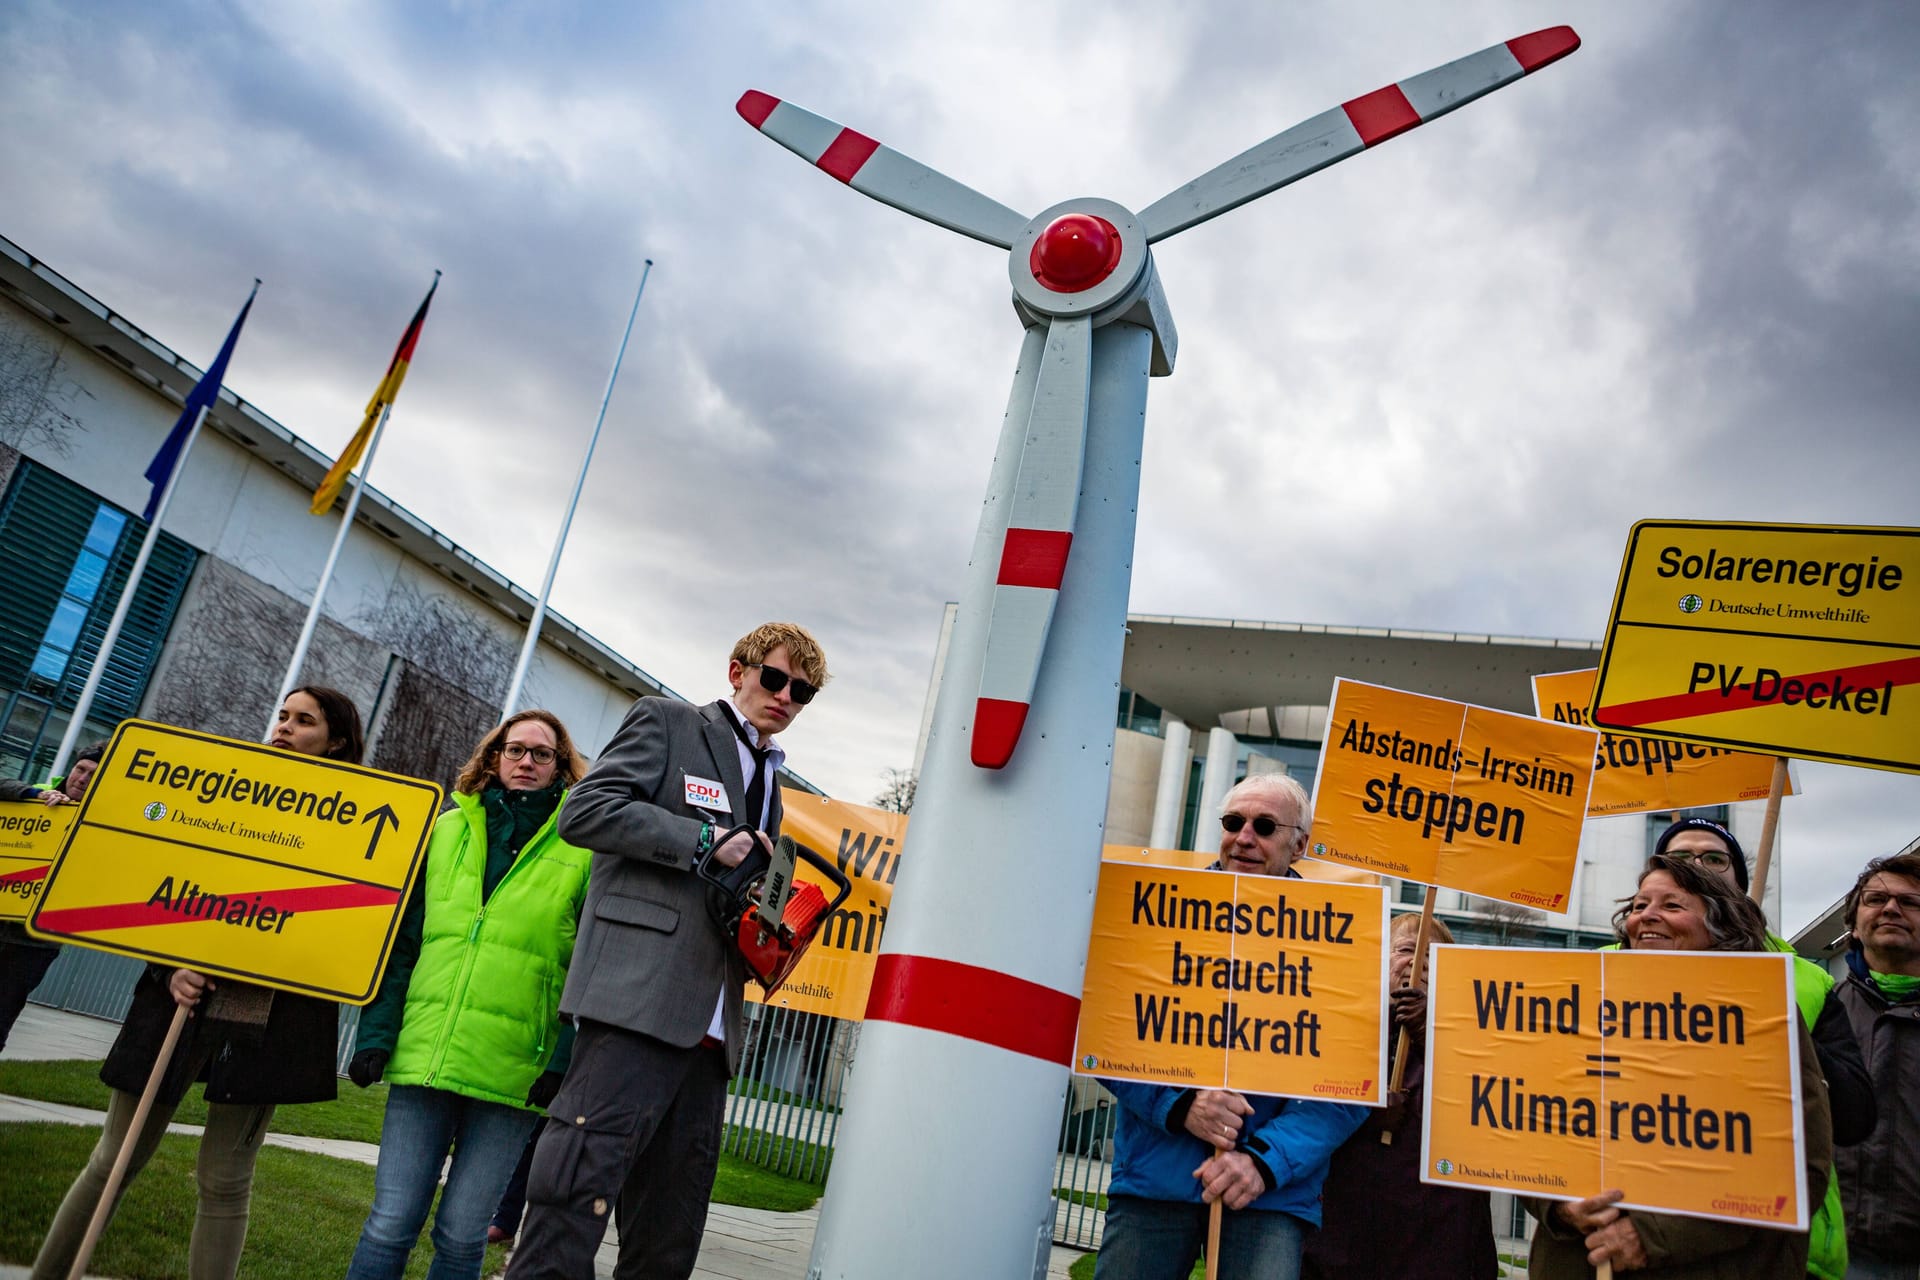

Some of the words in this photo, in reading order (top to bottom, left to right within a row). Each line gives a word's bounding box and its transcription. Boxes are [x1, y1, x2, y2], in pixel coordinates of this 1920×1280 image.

[1656, 546, 1904, 597] Solarenergie
[1708, 599, 1775, 617] Deutsche
[1776, 603, 1870, 624] Umwelthilfe
[1688, 662, 1894, 716] PV-Deckel
[1340, 719, 1575, 797] Abstands-Irrsinn
[125, 749, 358, 825] Energiewende
[687, 784, 720, 798] CDU
[689, 793, 708, 802] CSU
[1362, 773, 1525, 845] stoppen
[171, 809, 229, 833] Deutsche
[229, 823, 305, 849] Umwelthilfe
[1330, 847, 1364, 864] Deutsche
[1364, 854, 1411, 874] Umwelthilfe
[147, 876, 294, 934] Altmaier
[768, 871, 785, 910] DOLMAR
[1132, 880, 1354, 945] Klimaschutz
[1172, 941, 1313, 998] braucht
[1134, 992, 1322, 1058] Windkraft
[1473, 979, 1578, 1035] Wind
[1597, 992, 1746, 1045] ernten
[1102, 1058, 1142, 1075] Deutsche
[1142, 1062, 1196, 1079] Umwelthilfe
[1585, 1054, 1621, 1078] =
[1471, 1074, 1596, 1138] Klima
[1610, 1093, 1752, 1154] retten
[1458, 1163, 1505, 1182] Deutsche
[1505, 1168, 1568, 1188] Umwelthilfe
